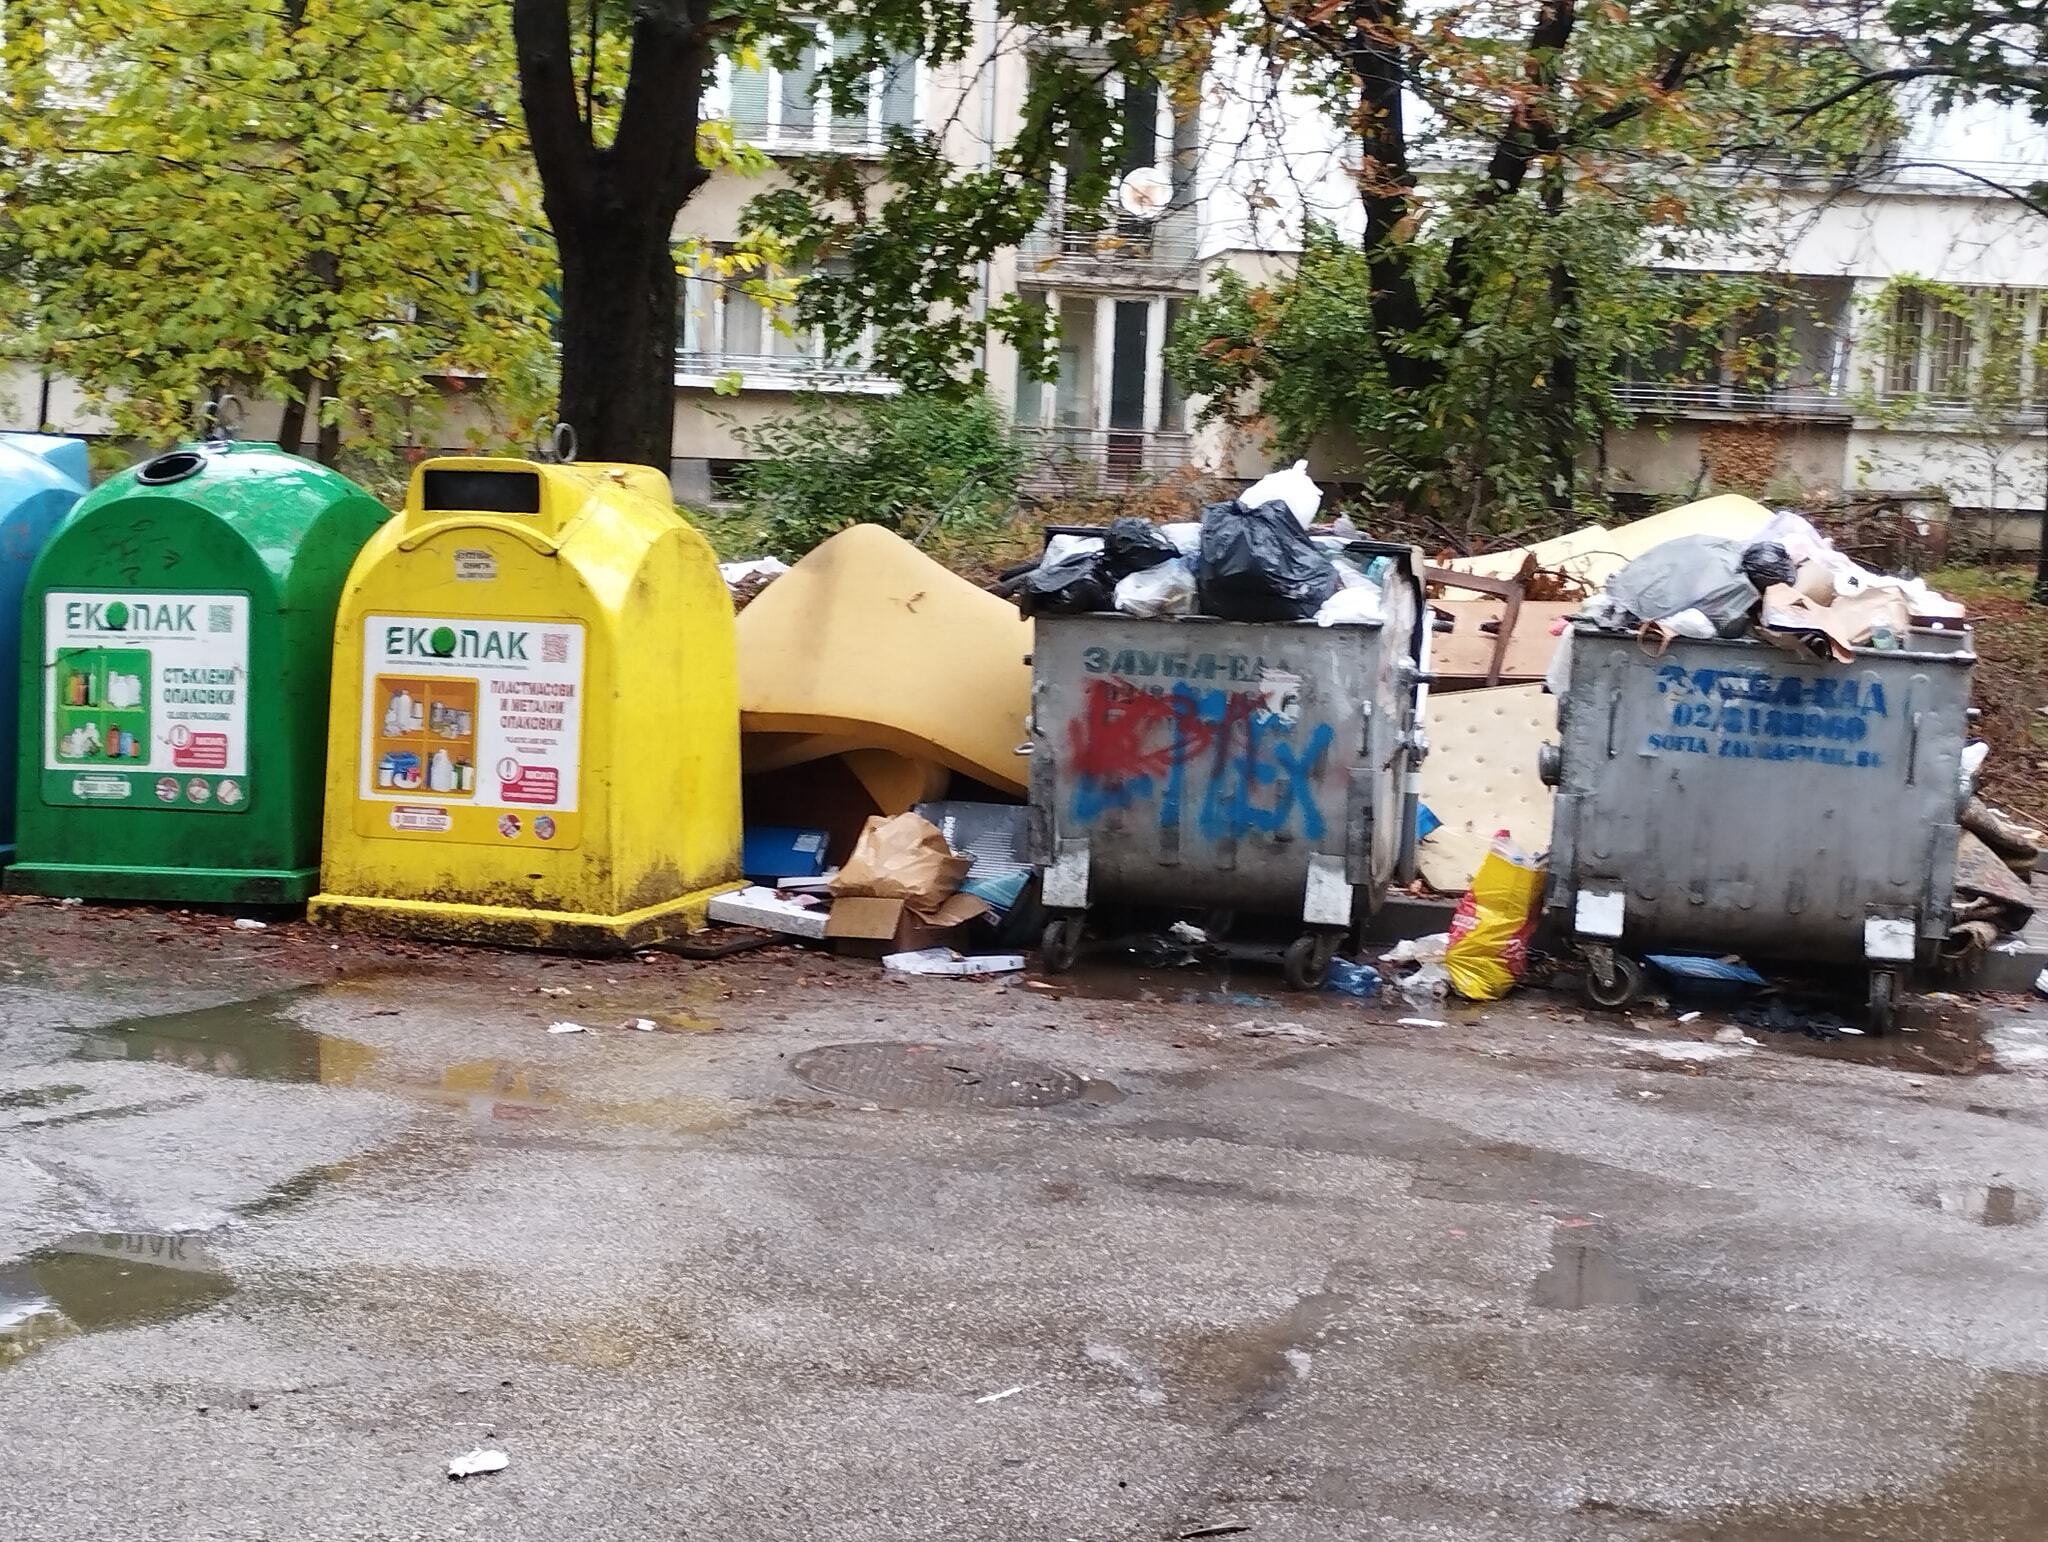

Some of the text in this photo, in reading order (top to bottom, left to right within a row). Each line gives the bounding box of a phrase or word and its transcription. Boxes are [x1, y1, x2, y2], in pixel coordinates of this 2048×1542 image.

[66, 600, 197, 632] ЕКОПАК
[385, 626, 530, 661] ЕКОПАК
[163, 688, 236, 705] ОПАКОВКИ
